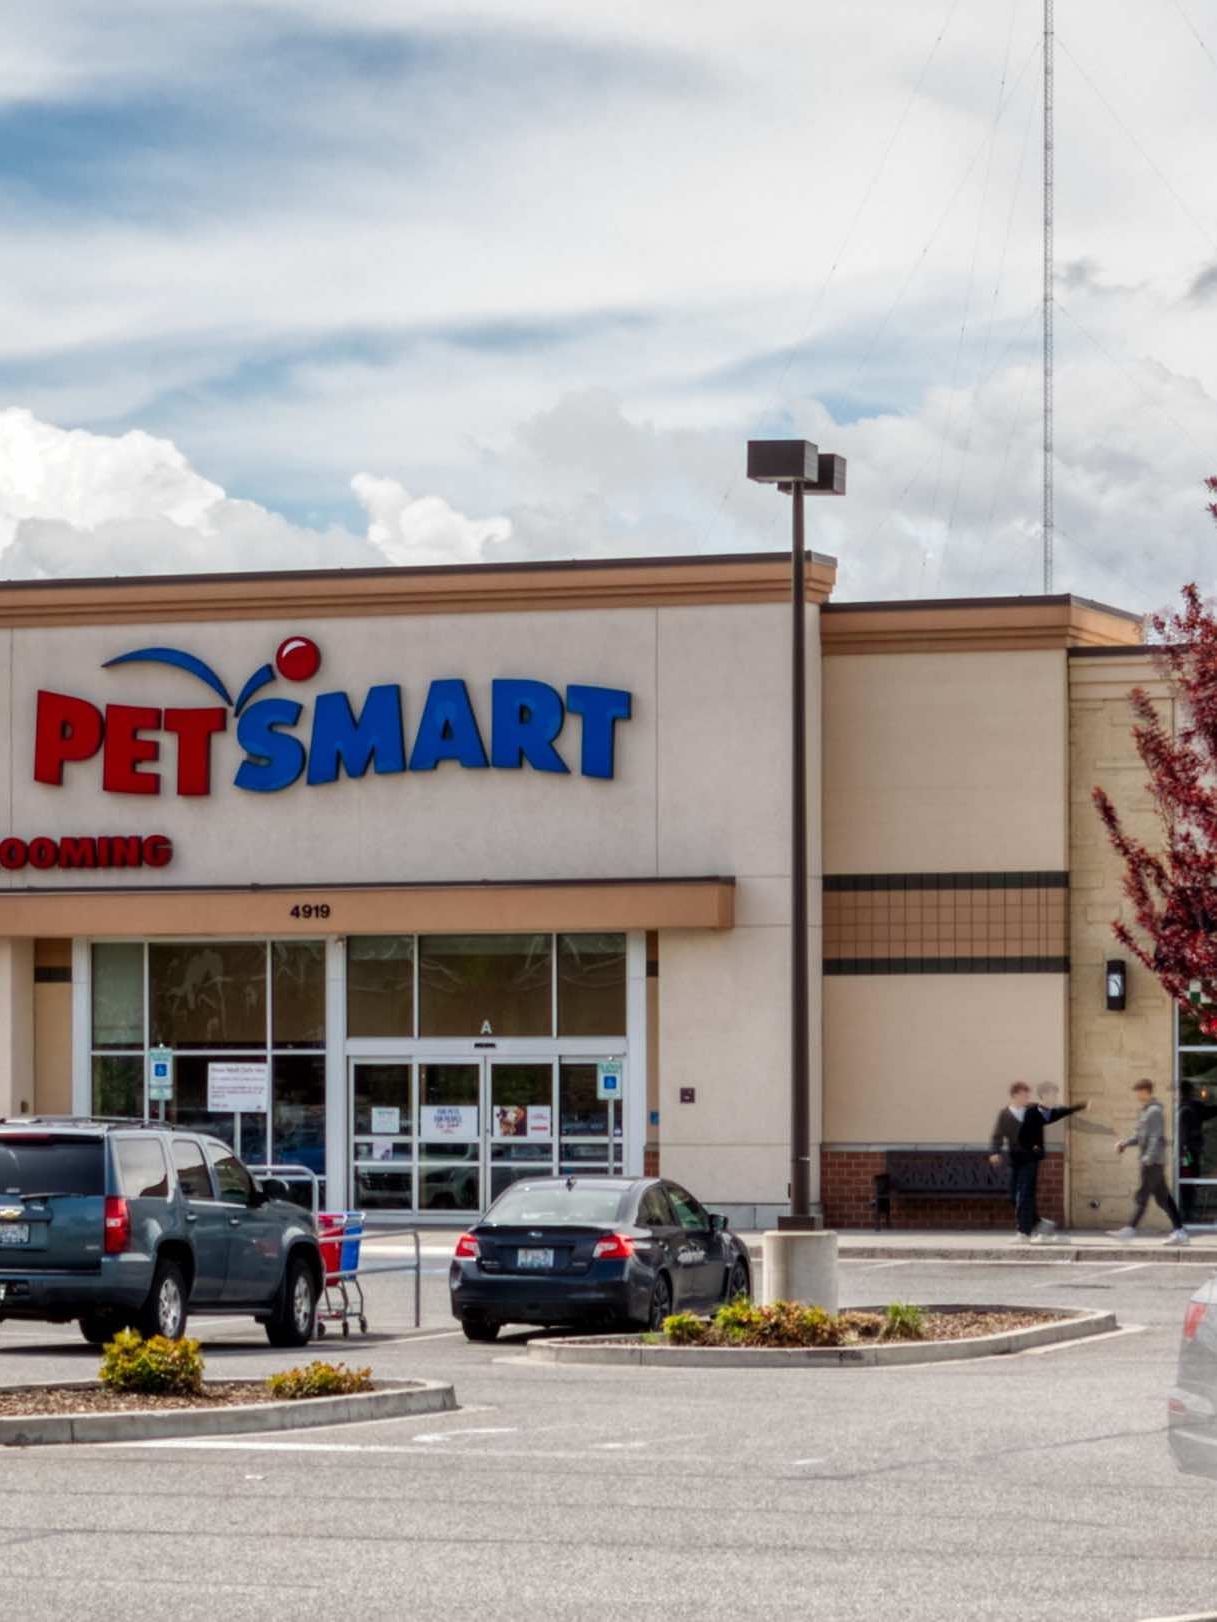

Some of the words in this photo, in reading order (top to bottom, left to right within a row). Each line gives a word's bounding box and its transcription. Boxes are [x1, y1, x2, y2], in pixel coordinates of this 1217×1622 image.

[34, 678, 632, 796] PETSMART
[290, 903, 331, 919] 4919
[480, 1019, 493, 1034] A
